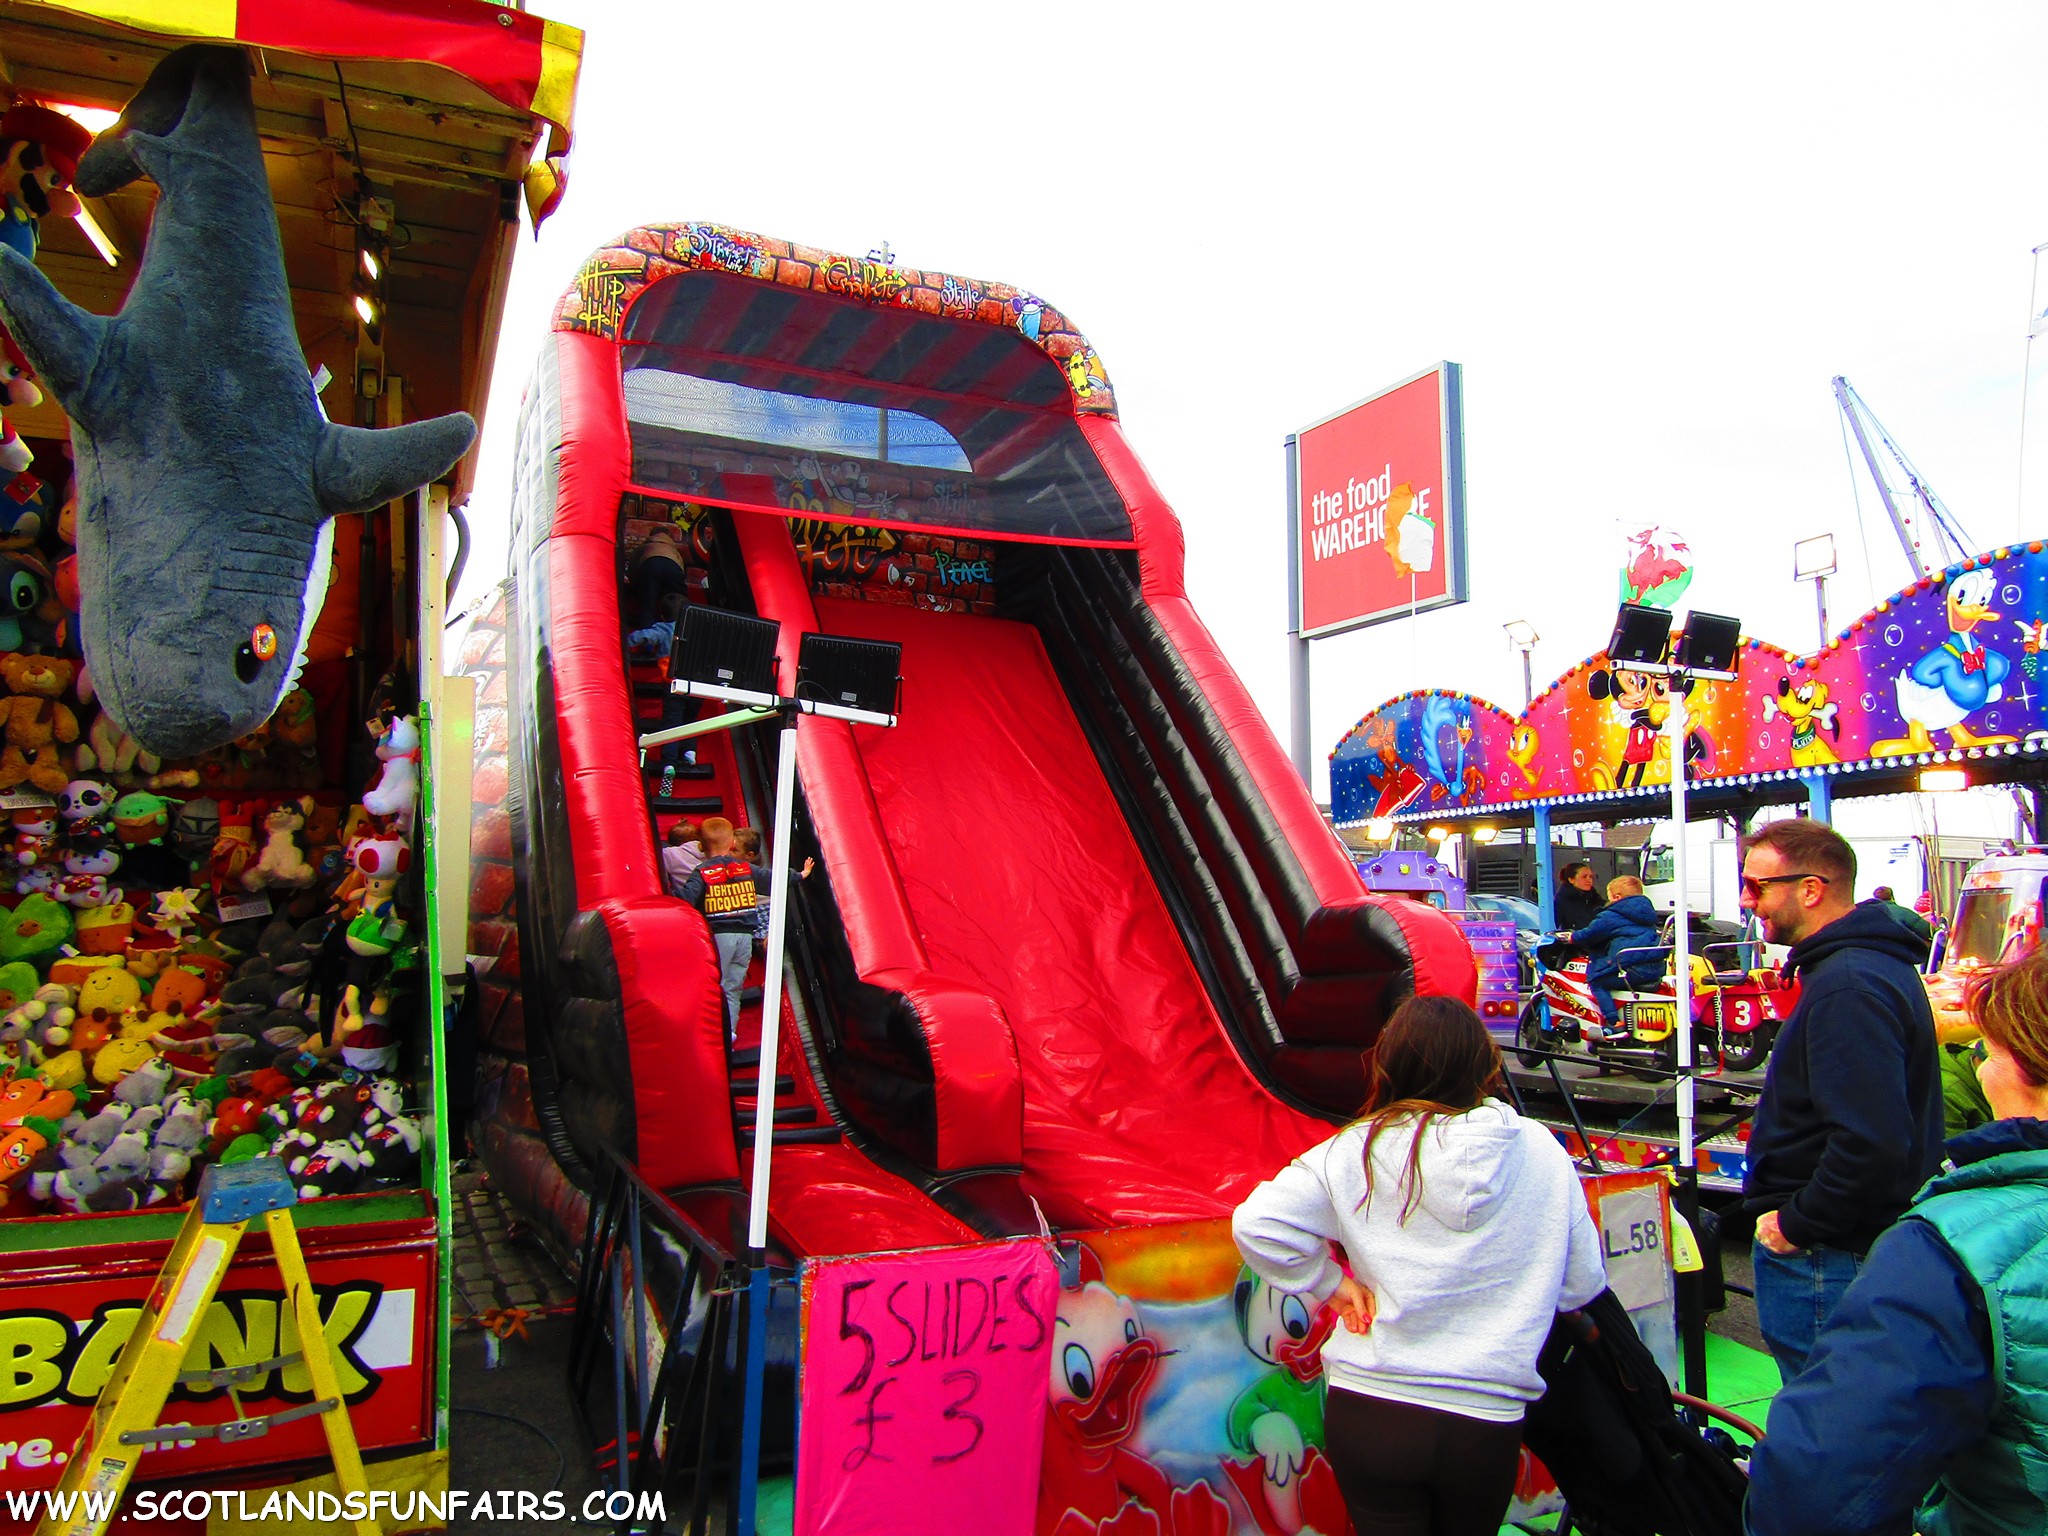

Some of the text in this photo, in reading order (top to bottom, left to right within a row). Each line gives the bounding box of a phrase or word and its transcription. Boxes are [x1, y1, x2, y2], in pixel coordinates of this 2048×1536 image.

[940, 276, 984, 320] Style
[1311, 463, 1391, 526] the food
[704, 892, 757, 913] MCQUEE
[1637, 1006, 1667, 1031] PATROL
[1734, 1000, 1751, 1026] 3
[838, 1273, 1046, 1396] 5 SLIDES
[842, 1368, 985, 1472] £ 3
